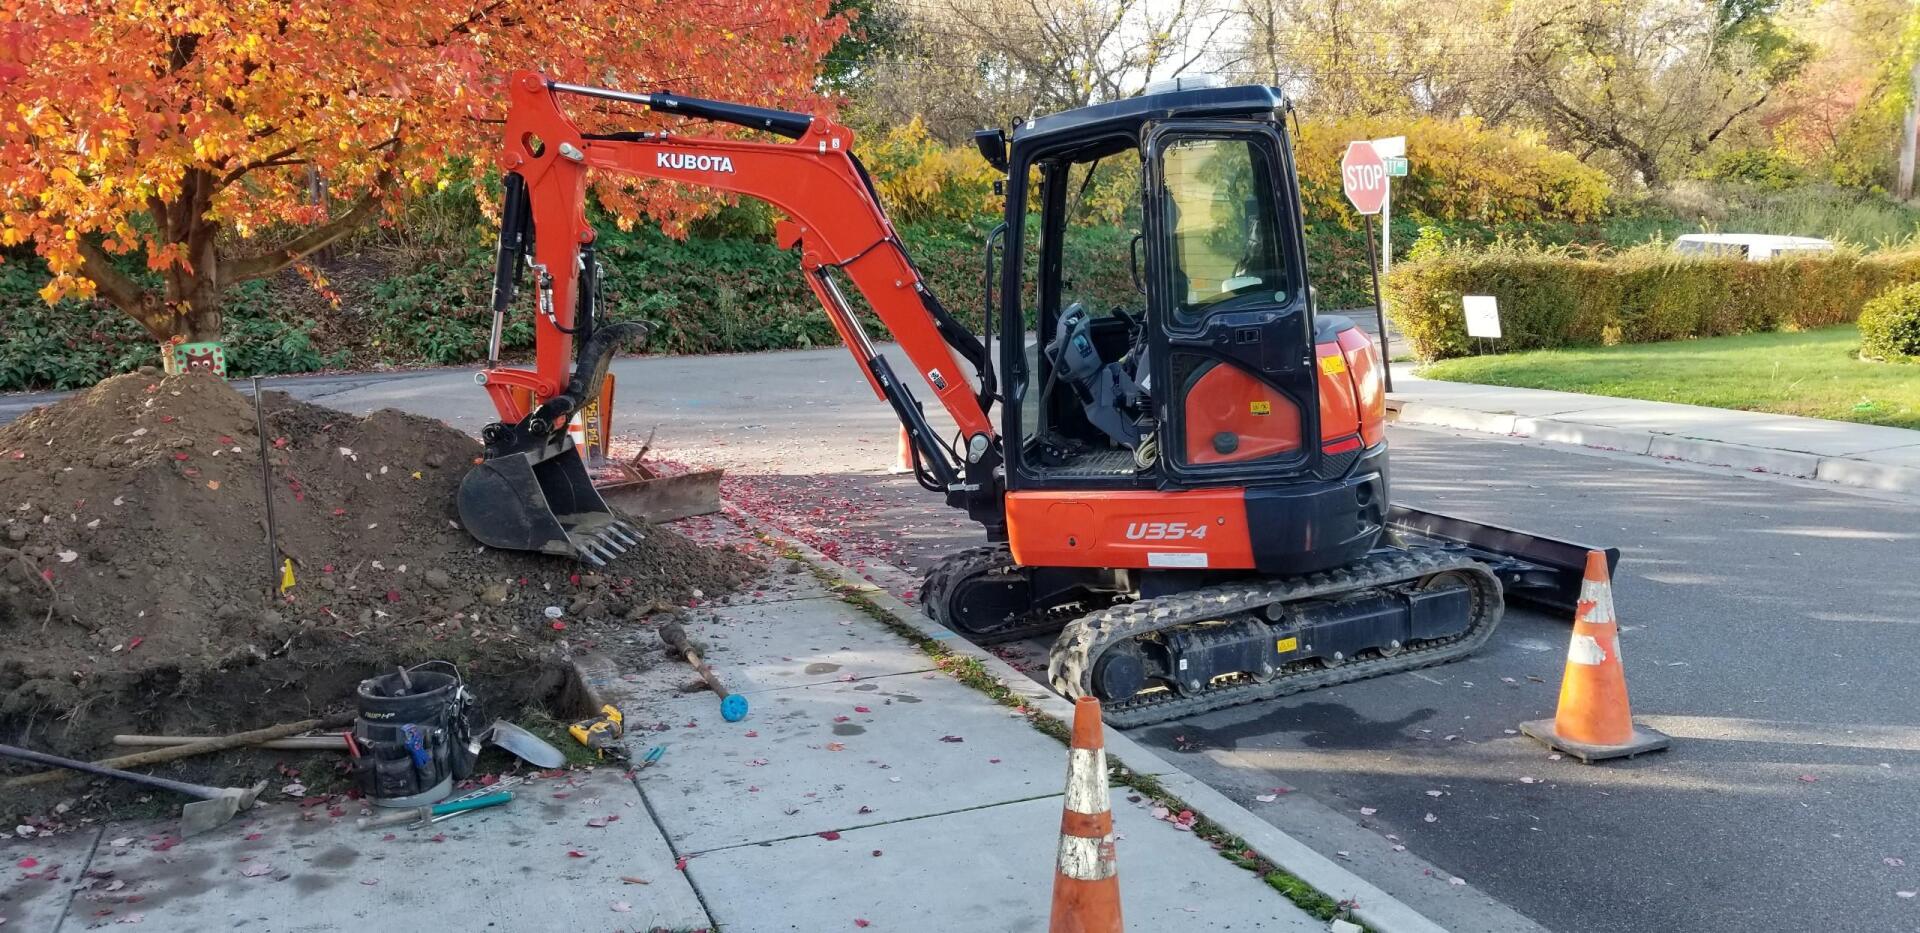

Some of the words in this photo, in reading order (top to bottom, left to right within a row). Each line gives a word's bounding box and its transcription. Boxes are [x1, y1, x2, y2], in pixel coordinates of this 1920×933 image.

[657, 152, 733, 172] KUBOTA
[1346, 164, 1382, 191] STOP
[587, 399, 599, 446] 754-054
[1126, 522, 1207, 540] U35-4
